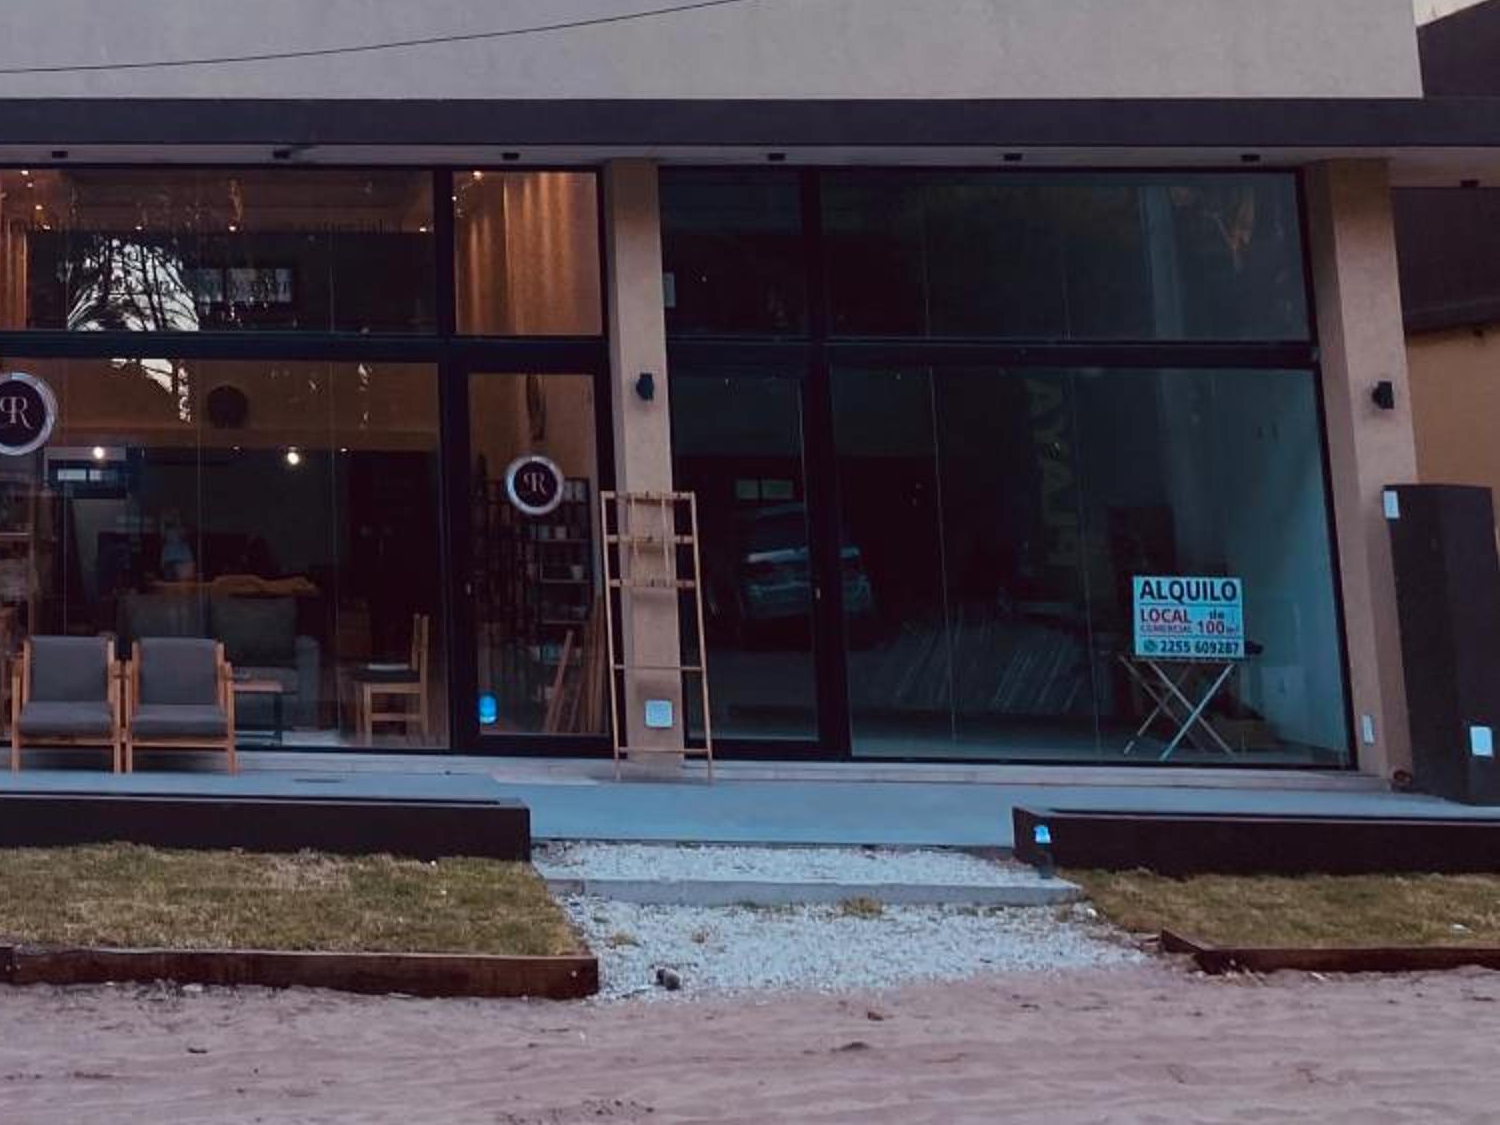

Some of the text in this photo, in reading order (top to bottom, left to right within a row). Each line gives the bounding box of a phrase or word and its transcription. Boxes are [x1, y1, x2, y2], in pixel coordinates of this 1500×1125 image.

[1140, 580, 1237, 603] ALQUILO
[1141, 609, 1188, 623] LOCAL
[1197, 620, 1225, 633] 100
[1160, 640, 1190, 653] 2255
